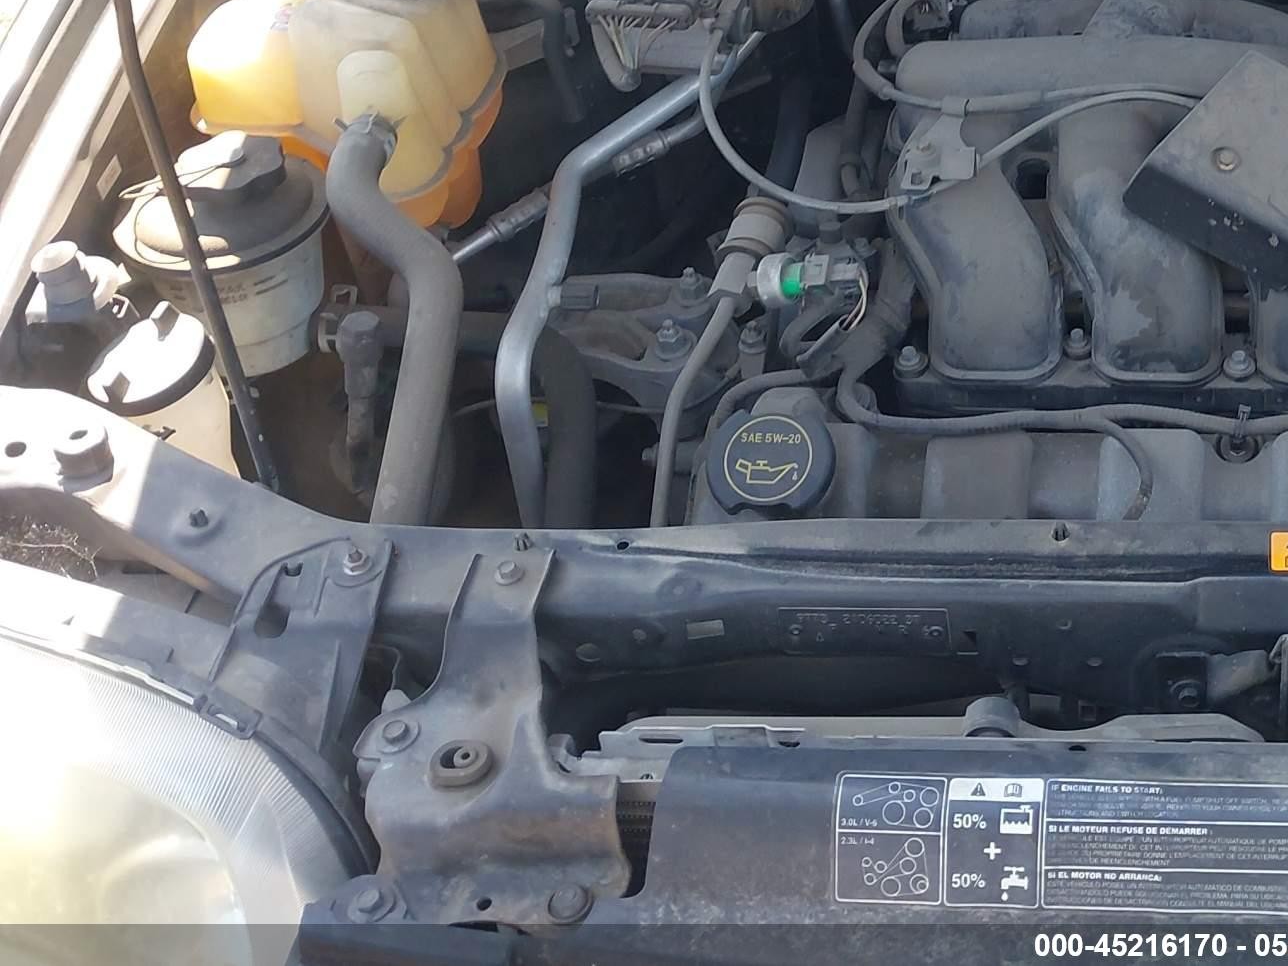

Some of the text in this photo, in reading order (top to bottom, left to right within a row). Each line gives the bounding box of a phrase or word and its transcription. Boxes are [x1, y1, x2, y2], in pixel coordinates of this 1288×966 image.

[741, 432, 801, 444] SAE 5W-20
[1095, 785, 1118, 793] FAILS
[1120, 786, 1132, 794] TO
[841, 818, 858, 827] 3.0L
[953, 814, 987, 829] 50%
[1049, 825, 1057, 833] SI
[1072, 826, 1108, 834] MOTEUR
[1110, 827, 1144, 835] REFUSE
[1058, 871, 1069, 879] EL
[951, 874, 986, 888] 50%
